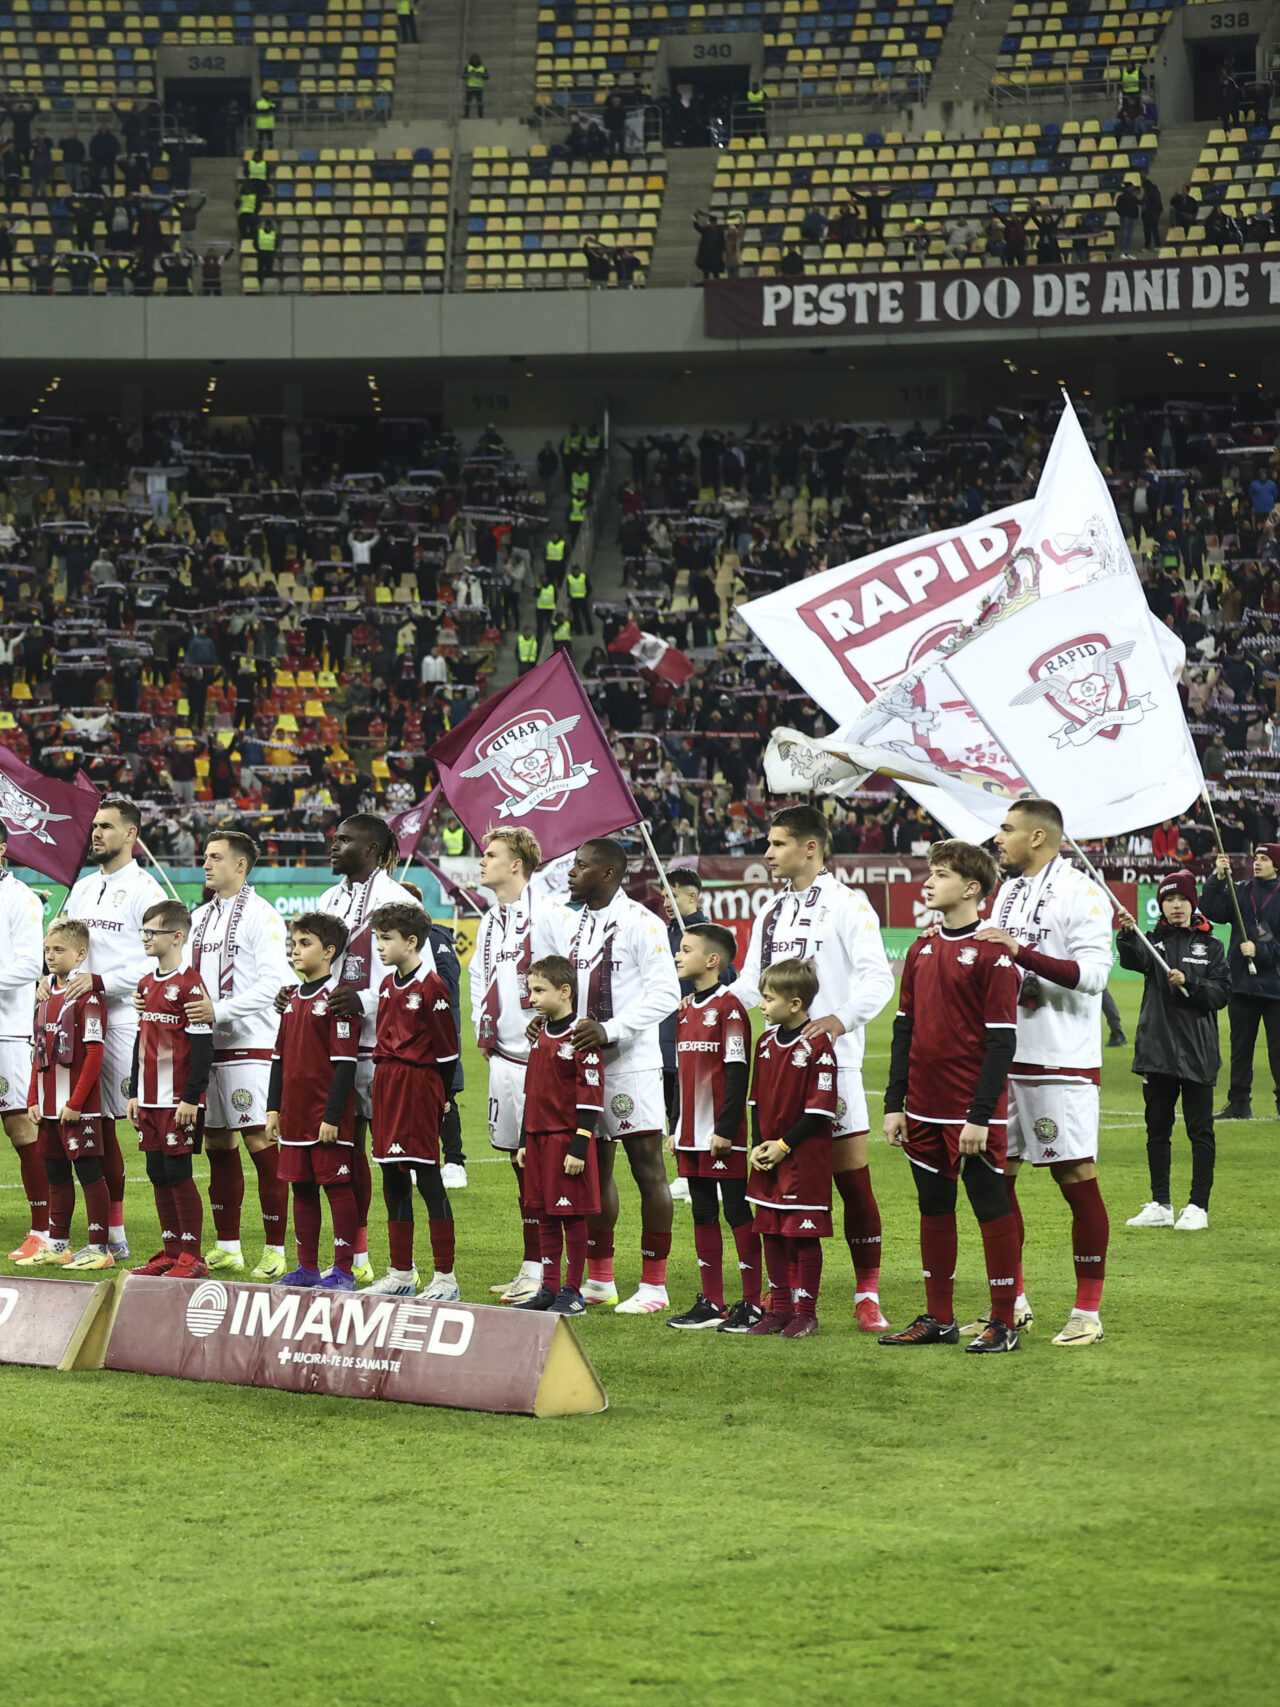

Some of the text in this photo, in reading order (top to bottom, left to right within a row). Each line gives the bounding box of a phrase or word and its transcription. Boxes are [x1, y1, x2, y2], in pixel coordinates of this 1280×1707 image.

[1210, 12, 1250, 29] 338
[693, 43, 732, 59] 340
[188, 56, 226, 71] 342
[762, 281, 904, 327] PESTE
[915, 276, 1021, 322] 100
[1033, 272, 1091, 317] DE
[1101, 267, 1181, 315] ANI
[1192, 263, 1250, 309] DE
[814, 524, 1010, 642] RAPID
[1044, 643, 1098, 675] RAPID
[862, 1236, 881, 1244] RAPID
[997, 1277, 1014, 1285] RAPID
[229, 1289, 475, 1356] IMAMED
[342, 1356, 353, 1369] DE
[355, 1358, 402, 1373] SANATATE
